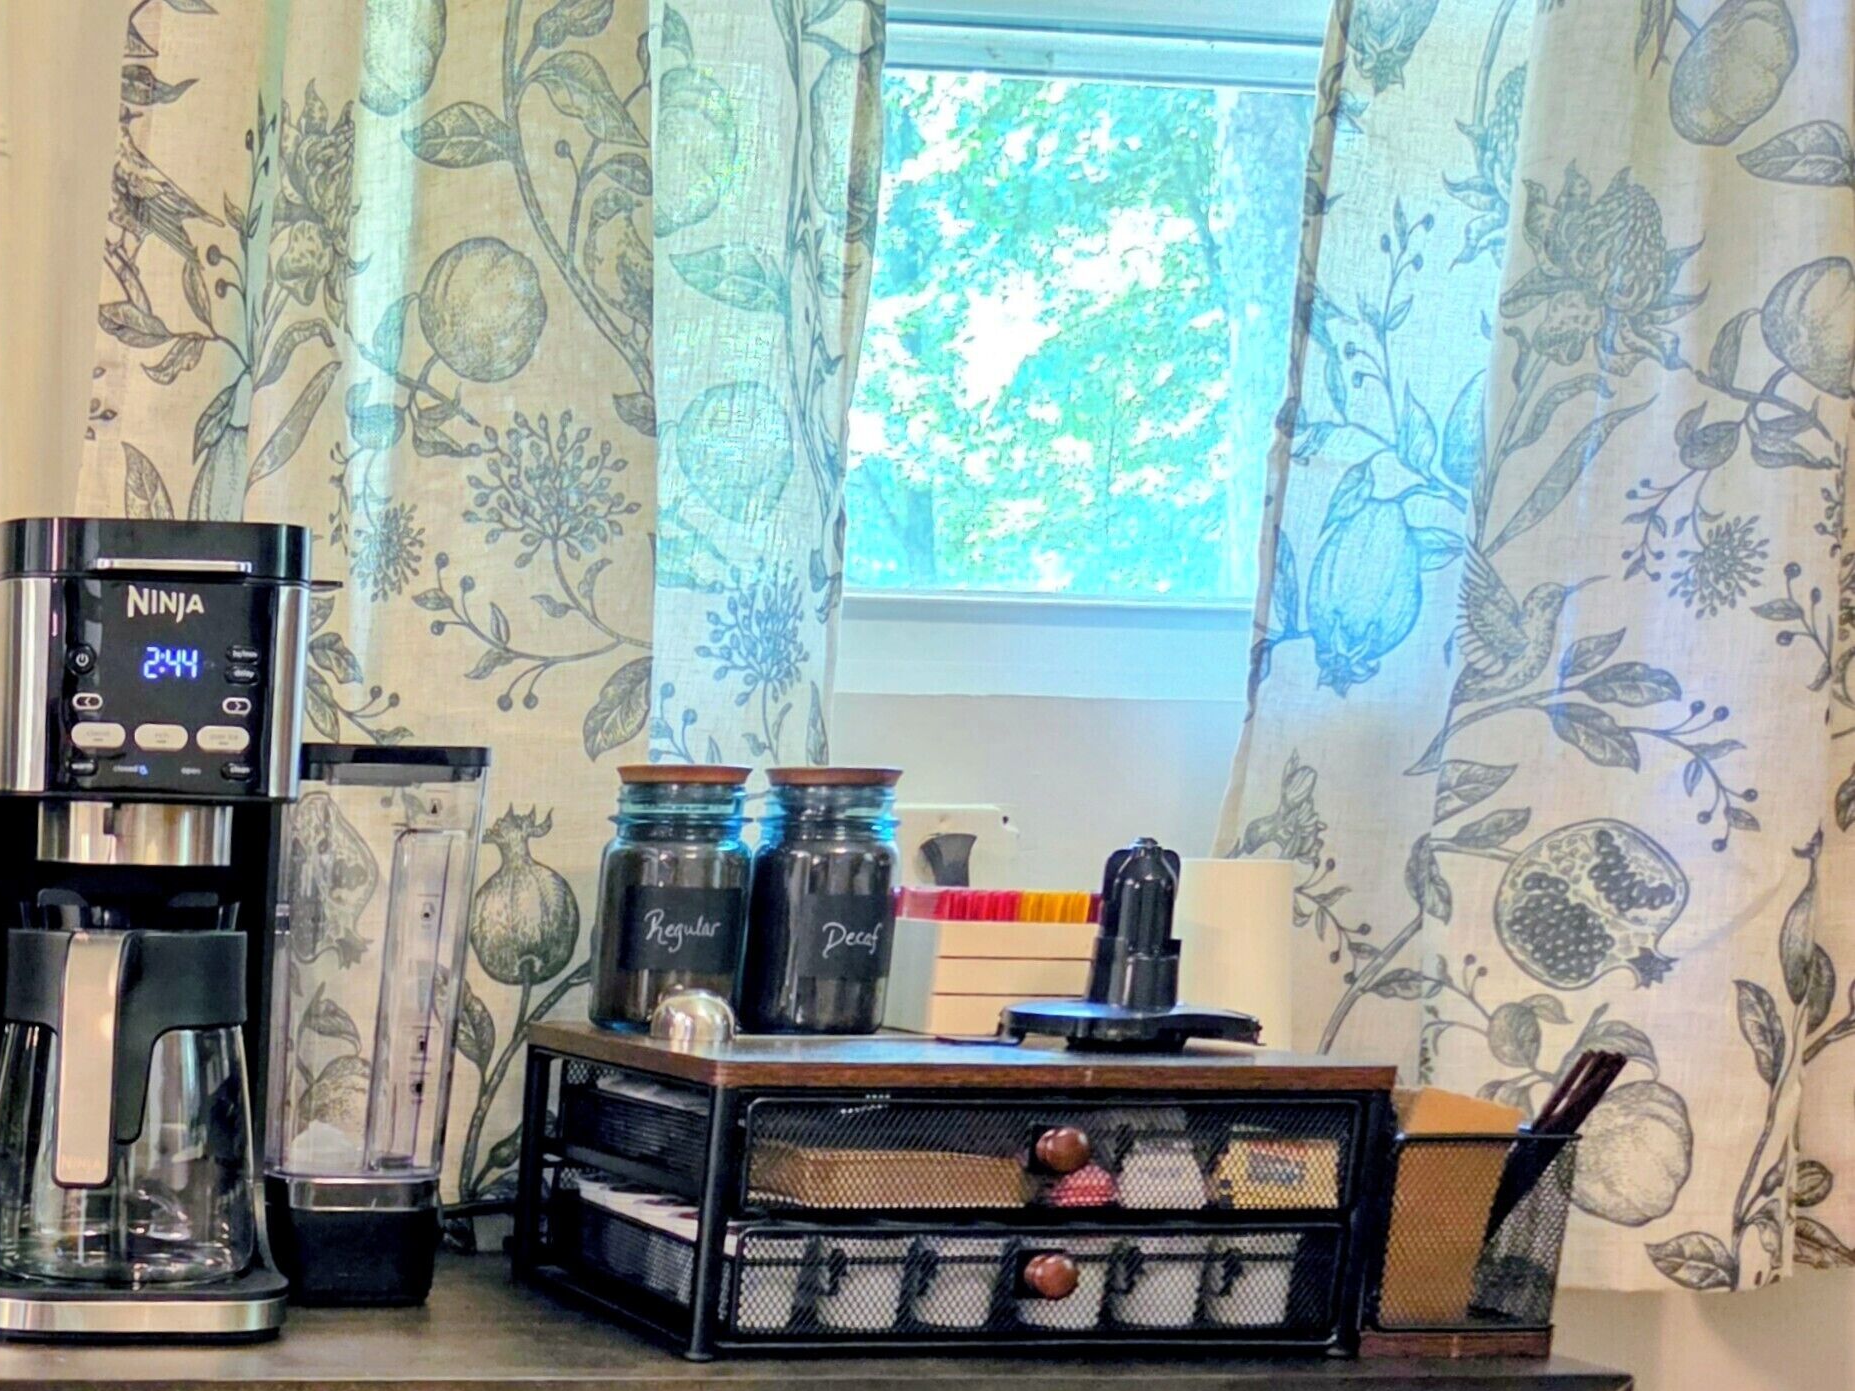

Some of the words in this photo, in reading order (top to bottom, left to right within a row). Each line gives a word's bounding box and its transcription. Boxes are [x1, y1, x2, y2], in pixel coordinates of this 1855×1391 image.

[126, 584, 205, 623] NINJA
[144, 647, 198, 678] 2:44
[644, 908, 721, 954] Regular
[822, 920, 883, 959] Decaf
